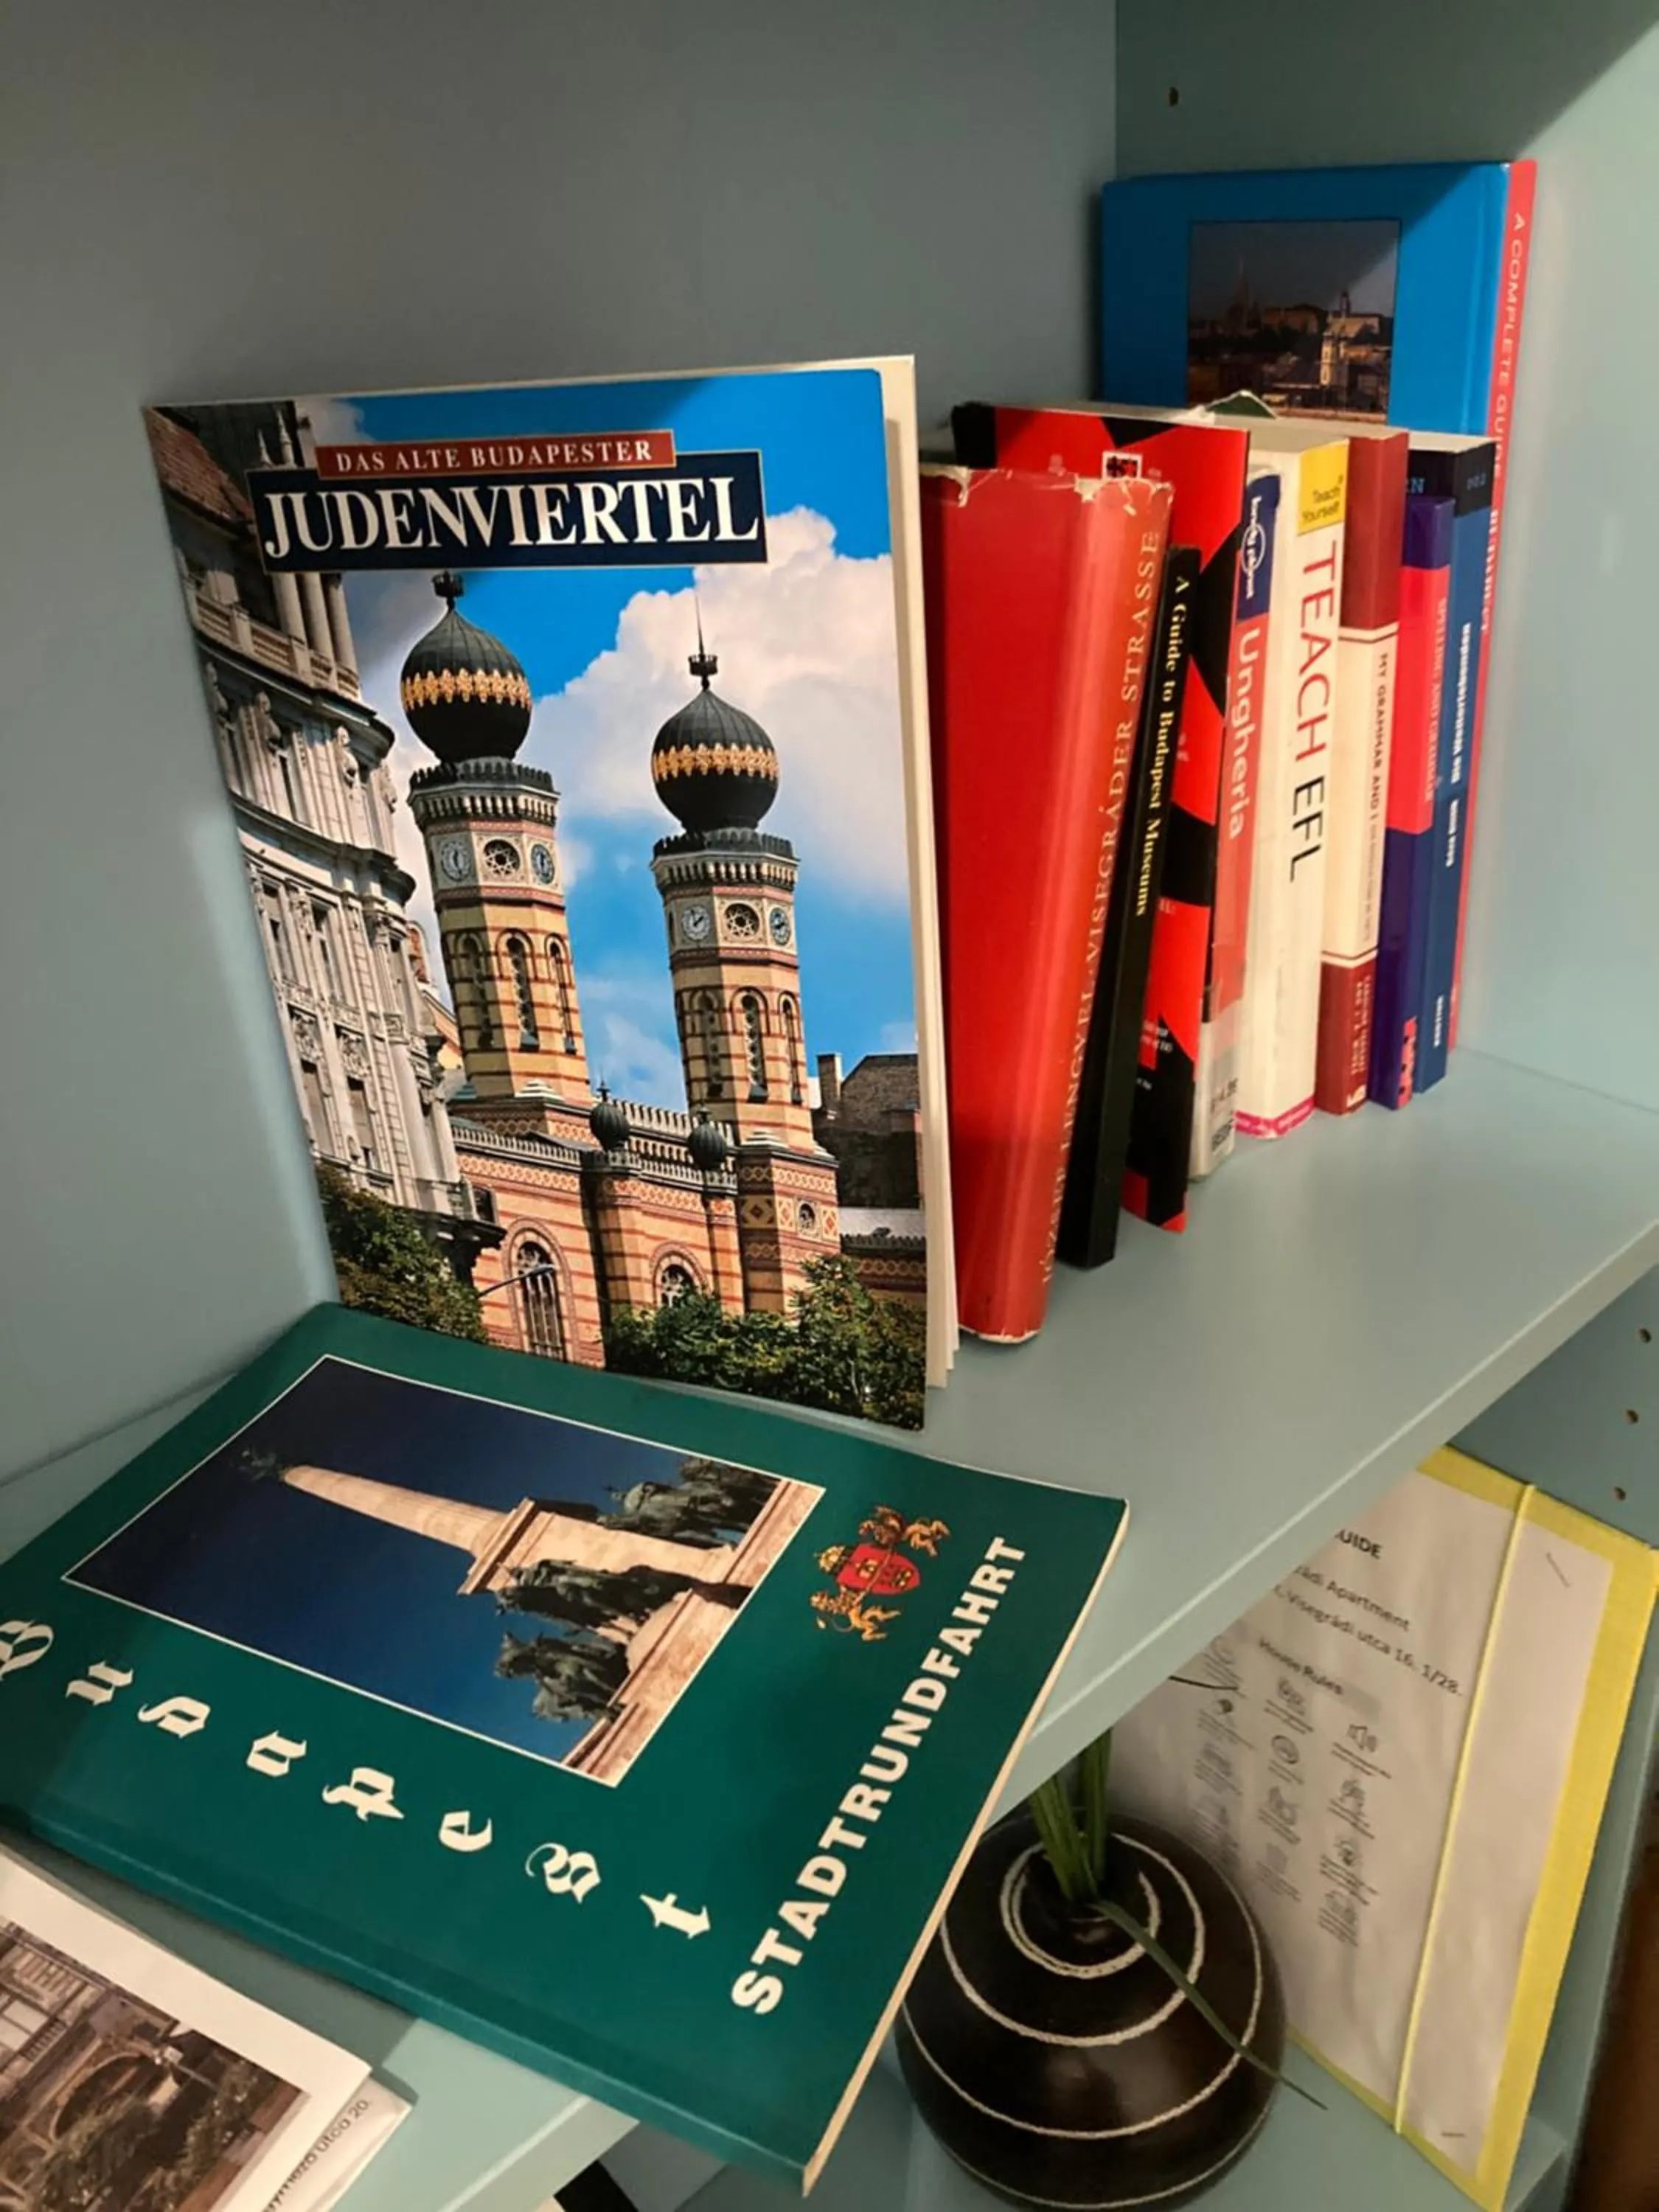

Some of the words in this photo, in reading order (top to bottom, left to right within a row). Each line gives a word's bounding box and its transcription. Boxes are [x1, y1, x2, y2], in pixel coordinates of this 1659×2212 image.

[1513, 212, 1526, 231] A
[1498, 240, 1523, 386] COMPLETE
[336, 452, 385, 473] DAS
[395, 448, 462, 470] ALTE
[472, 439, 653, 467] BUDAPESTER
[264, 476, 759, 558] JUDENVIERTEL
[1302, 501, 1339, 524] Yourself
[1313, 486, 1340, 504] Teach
[1175, 577, 1191, 594] A
[1166, 603, 1188, 671] Guide
[1295, 540, 1338, 762] TEACH
[1377, 653, 1389, 678] MY
[1163, 680, 1176, 703] to
[1229, 627, 1260, 840] Ungheria
[1373, 684, 1387, 770] GRAMMAR
[1149, 710, 1175, 810] Budapest
[1370, 775, 1381, 810] AND
[1062, 992, 1095, 1151] LENGYEL
[1085, 720, 1133, 964] VISEGRÁDER
[1121, 531, 1159, 703] STRASSE
[1290, 775, 1325, 883] EFL
[1136, 817, 1162, 917] Museums
[1335, 1528, 1381, 1559] UIDE
[1327, 1579, 1410, 1632] Apartment
[1357, 1630, 1391, 1655] utca
[730, 1536, 1026, 2015] STADTRUNDFAHRT
